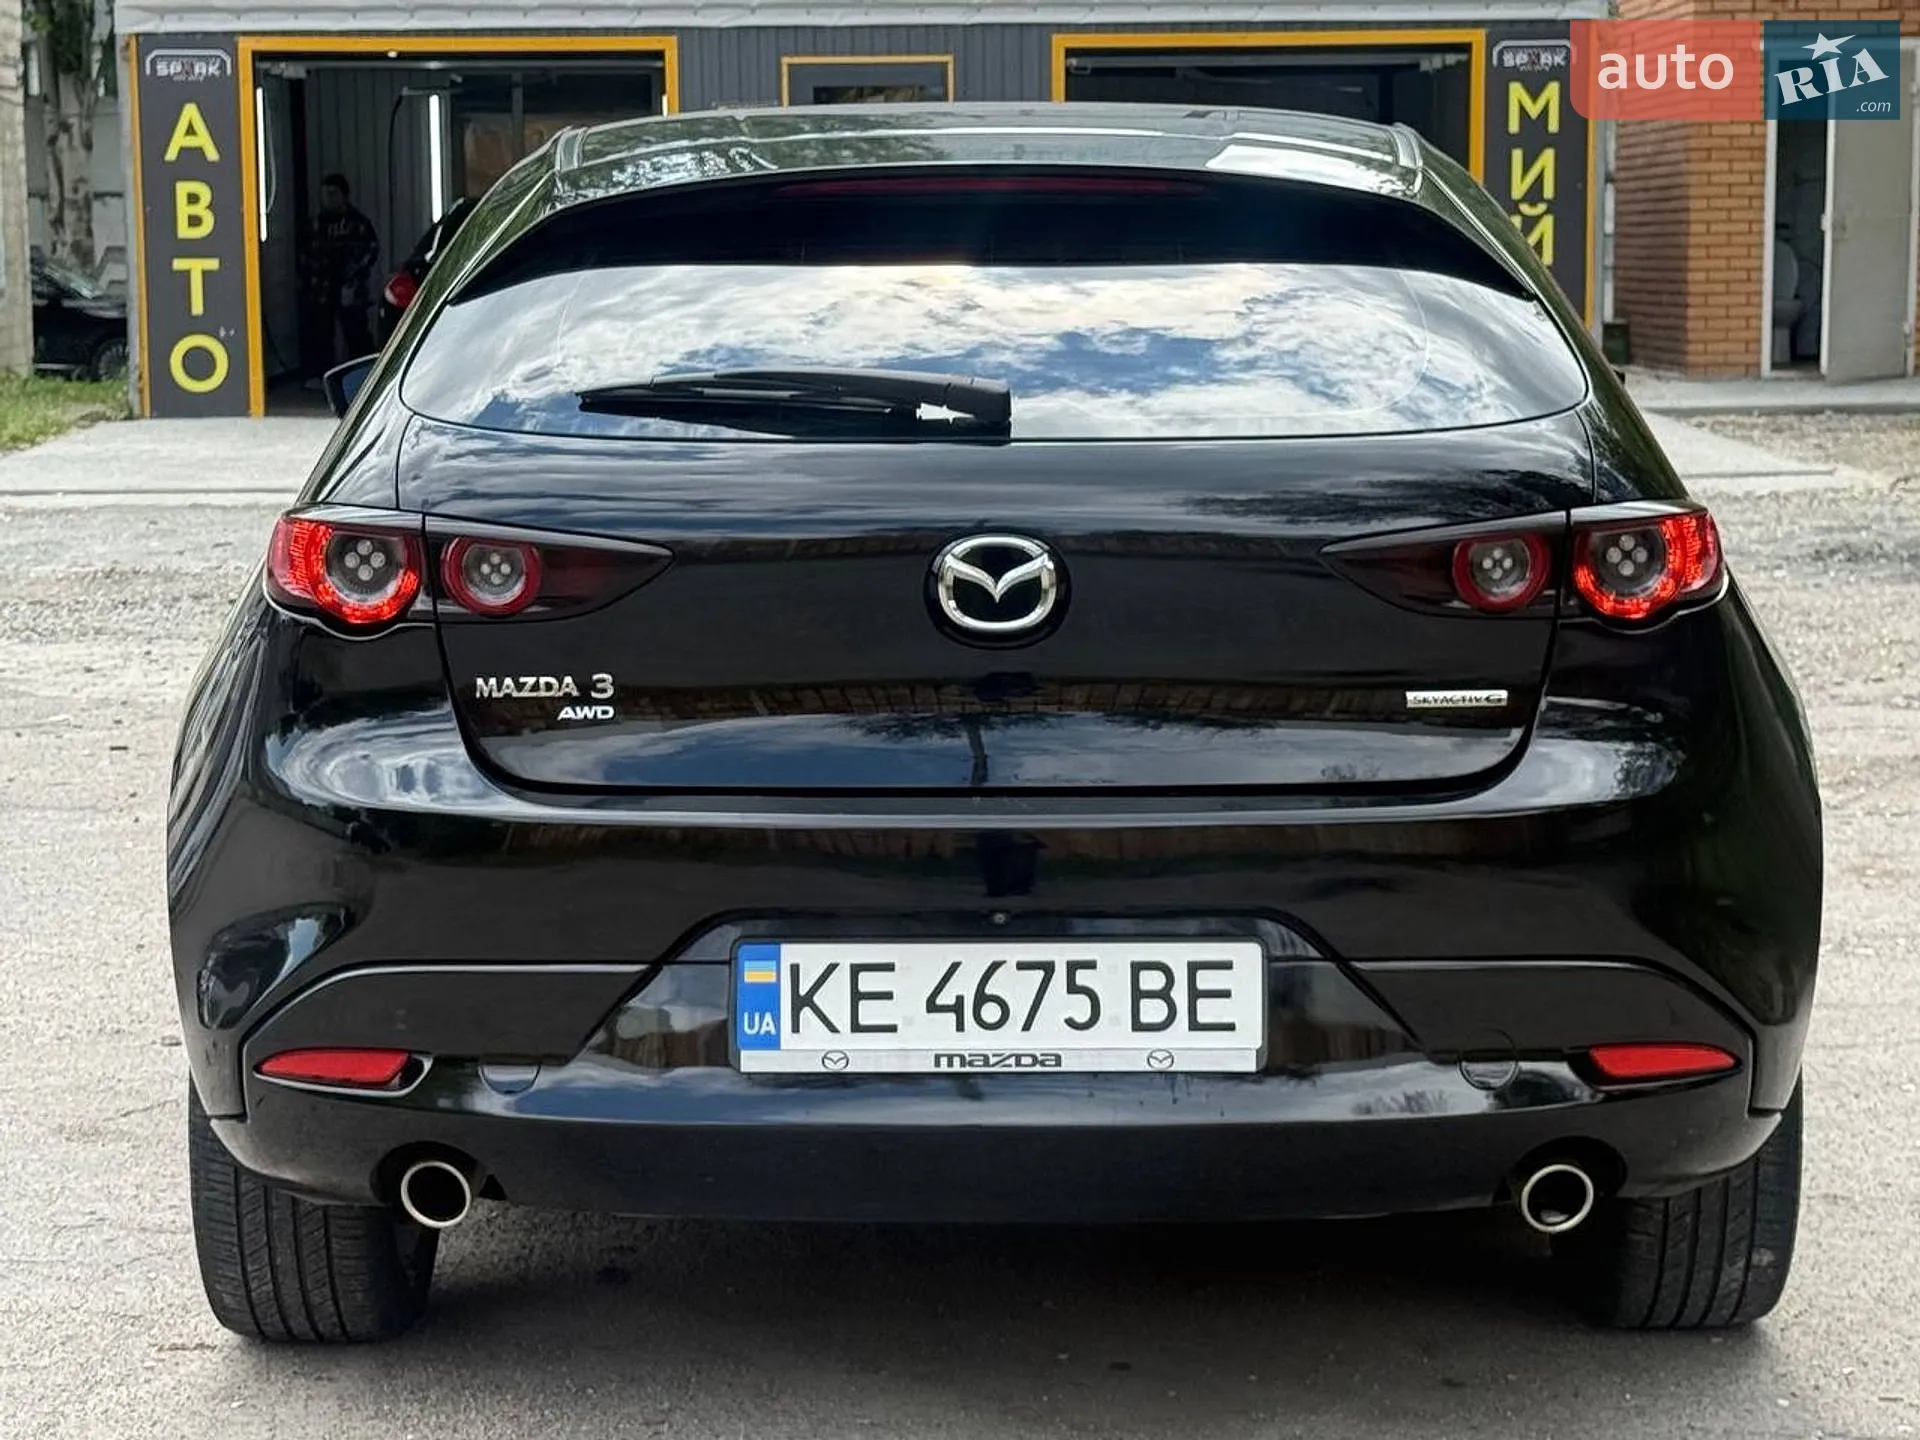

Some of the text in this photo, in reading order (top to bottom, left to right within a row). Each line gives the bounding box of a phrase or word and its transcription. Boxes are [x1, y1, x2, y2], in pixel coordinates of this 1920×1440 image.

[163, 103, 229, 393] АВТО
[474, 673, 615, 699] MAZDA 3
[557, 705, 615, 721] AWD
[789, 960, 1236, 1034] KE 4675 BE
[743, 1013, 777, 1036] UA
